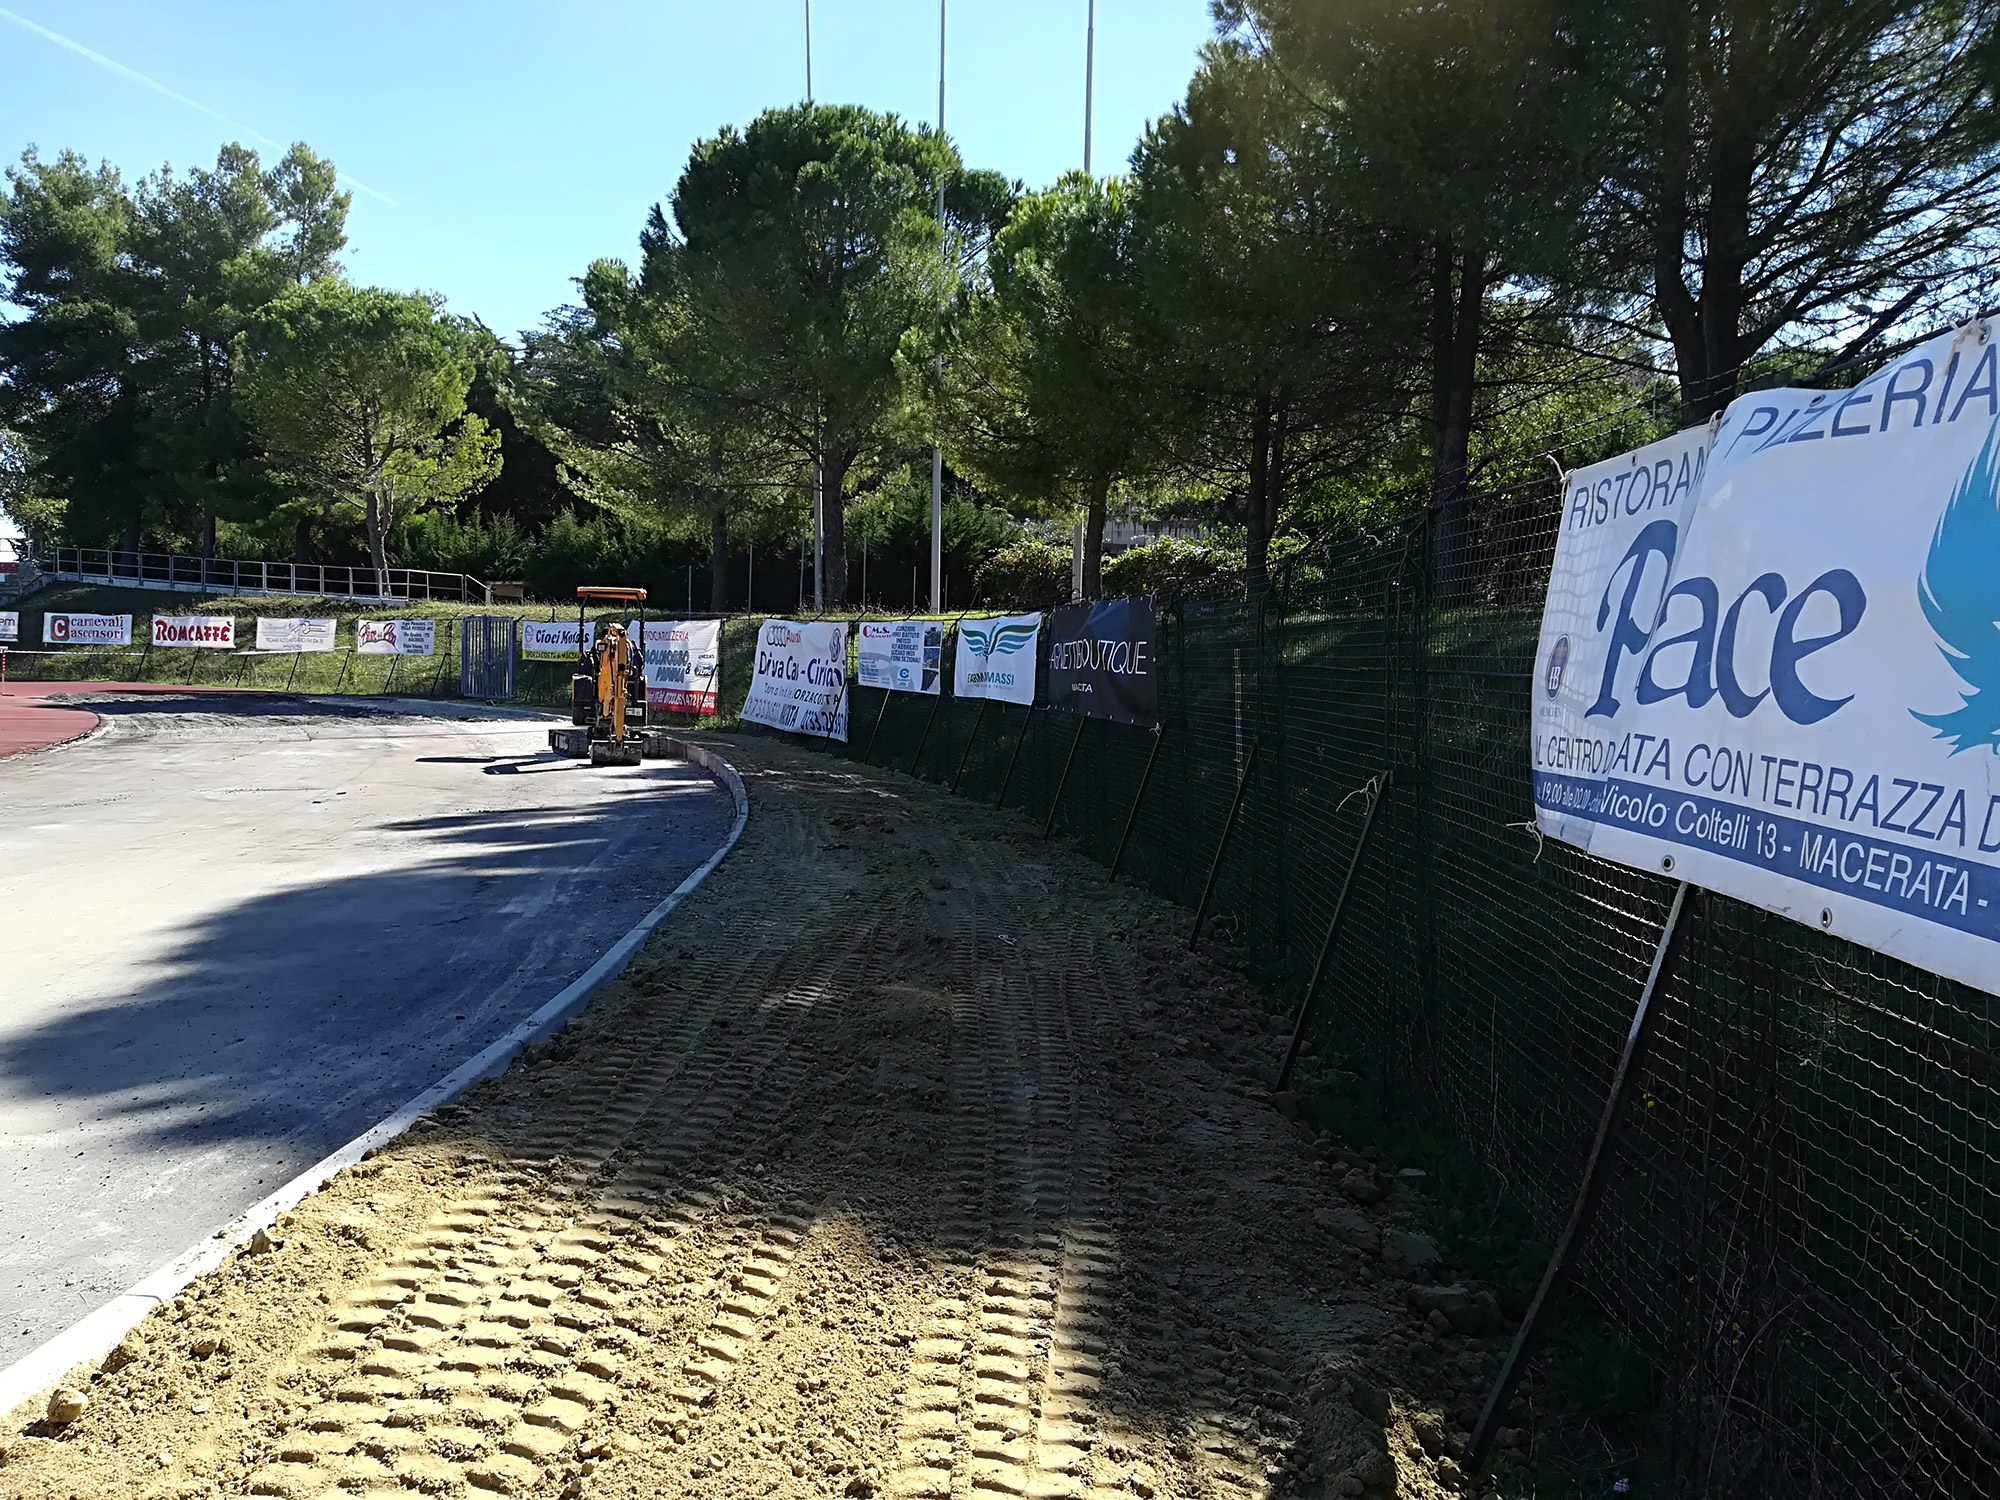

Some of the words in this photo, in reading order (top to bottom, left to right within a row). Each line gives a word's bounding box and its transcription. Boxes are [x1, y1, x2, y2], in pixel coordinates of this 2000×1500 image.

[71, 616, 123, 627] carnevali
[1584, 519, 1867, 726] Pace
[71, 627, 123, 639] ascensori
[536, 629, 561, 644] Cioci
[786, 629, 802, 643] Audi
[1546, 735, 1603, 774] CENTRO
[1684, 743, 1753, 797] CON
[1761, 754, 1966, 847] TERRAZZA
[1600, 783, 1668, 828] Vicolo
[1675, 800, 1751, 850] Coltelli
[1756, 820, 1777, 860] 13
[1799, 830, 1969, 916] MACERATA
